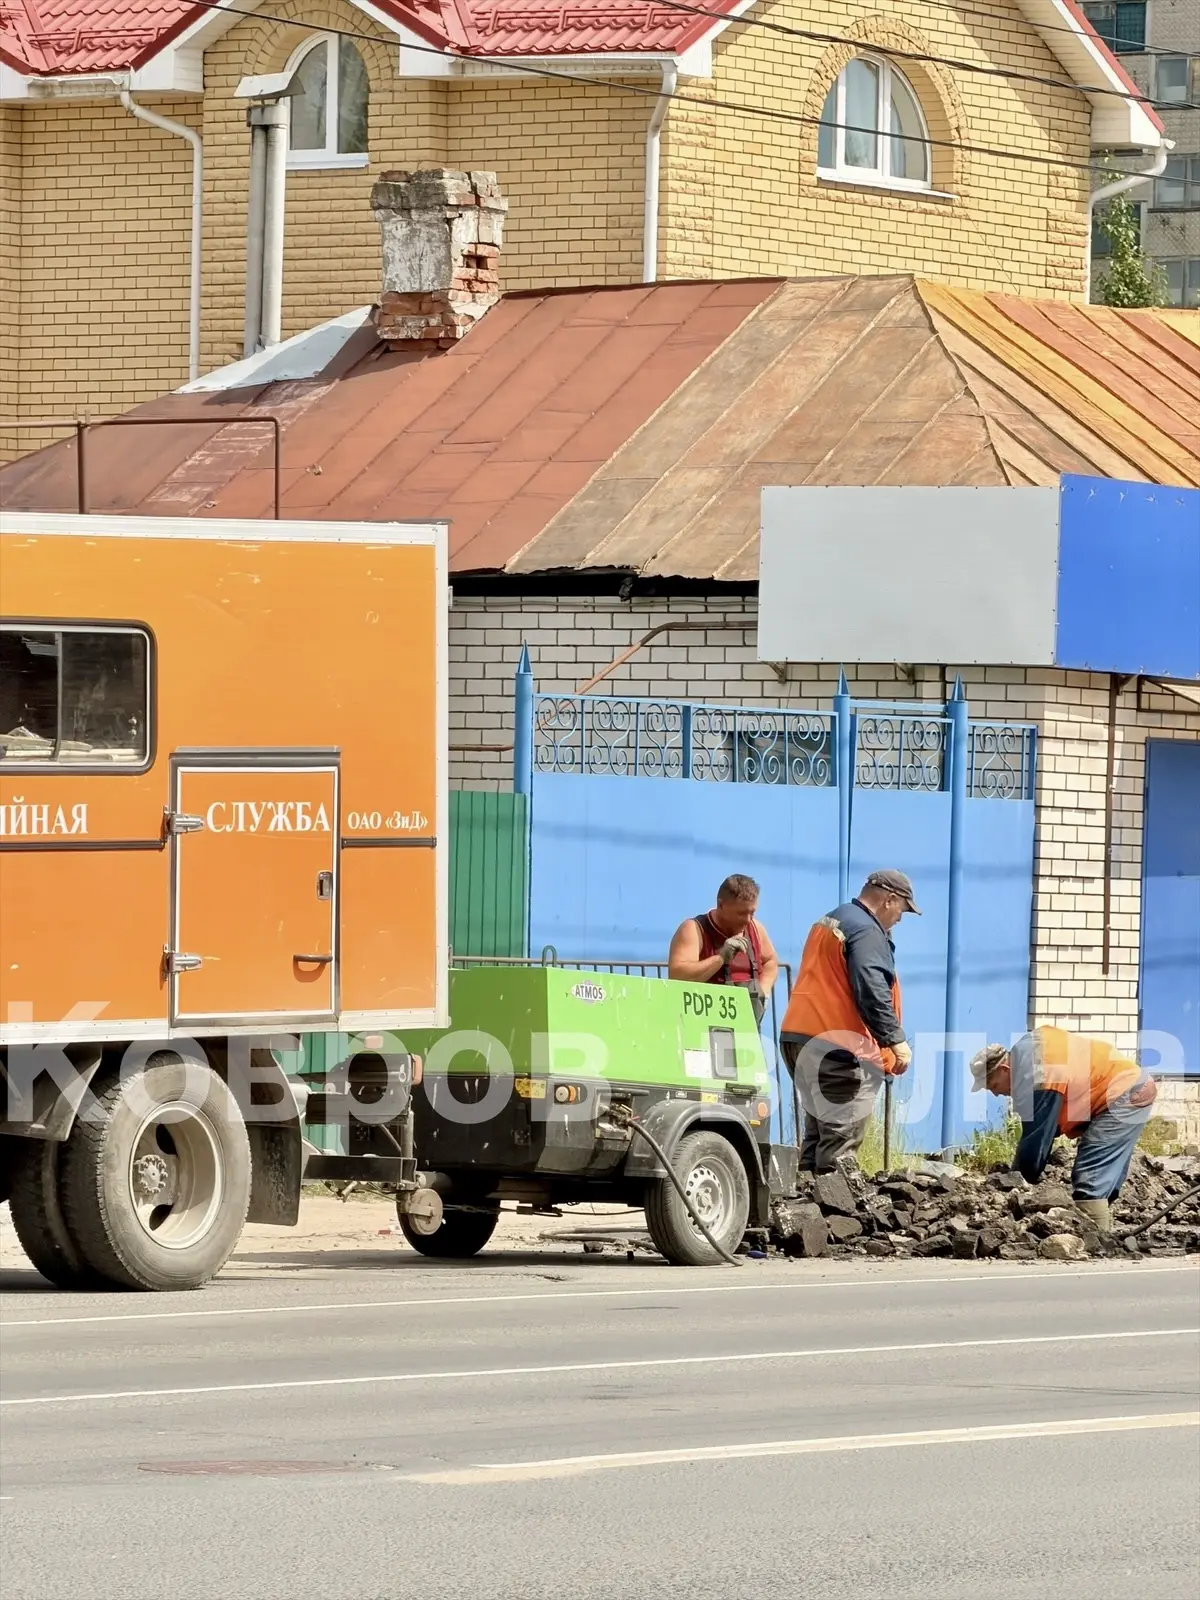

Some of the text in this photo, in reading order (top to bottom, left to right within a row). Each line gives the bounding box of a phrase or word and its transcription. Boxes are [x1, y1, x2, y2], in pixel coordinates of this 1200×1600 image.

[206, 801, 331, 833] СЛУЖБА
[347, 811, 428, 832] ОАО «ЗиД»
[574, 984, 603, 1000] ATMOS
[683, 991, 737, 1020] PDP 35
